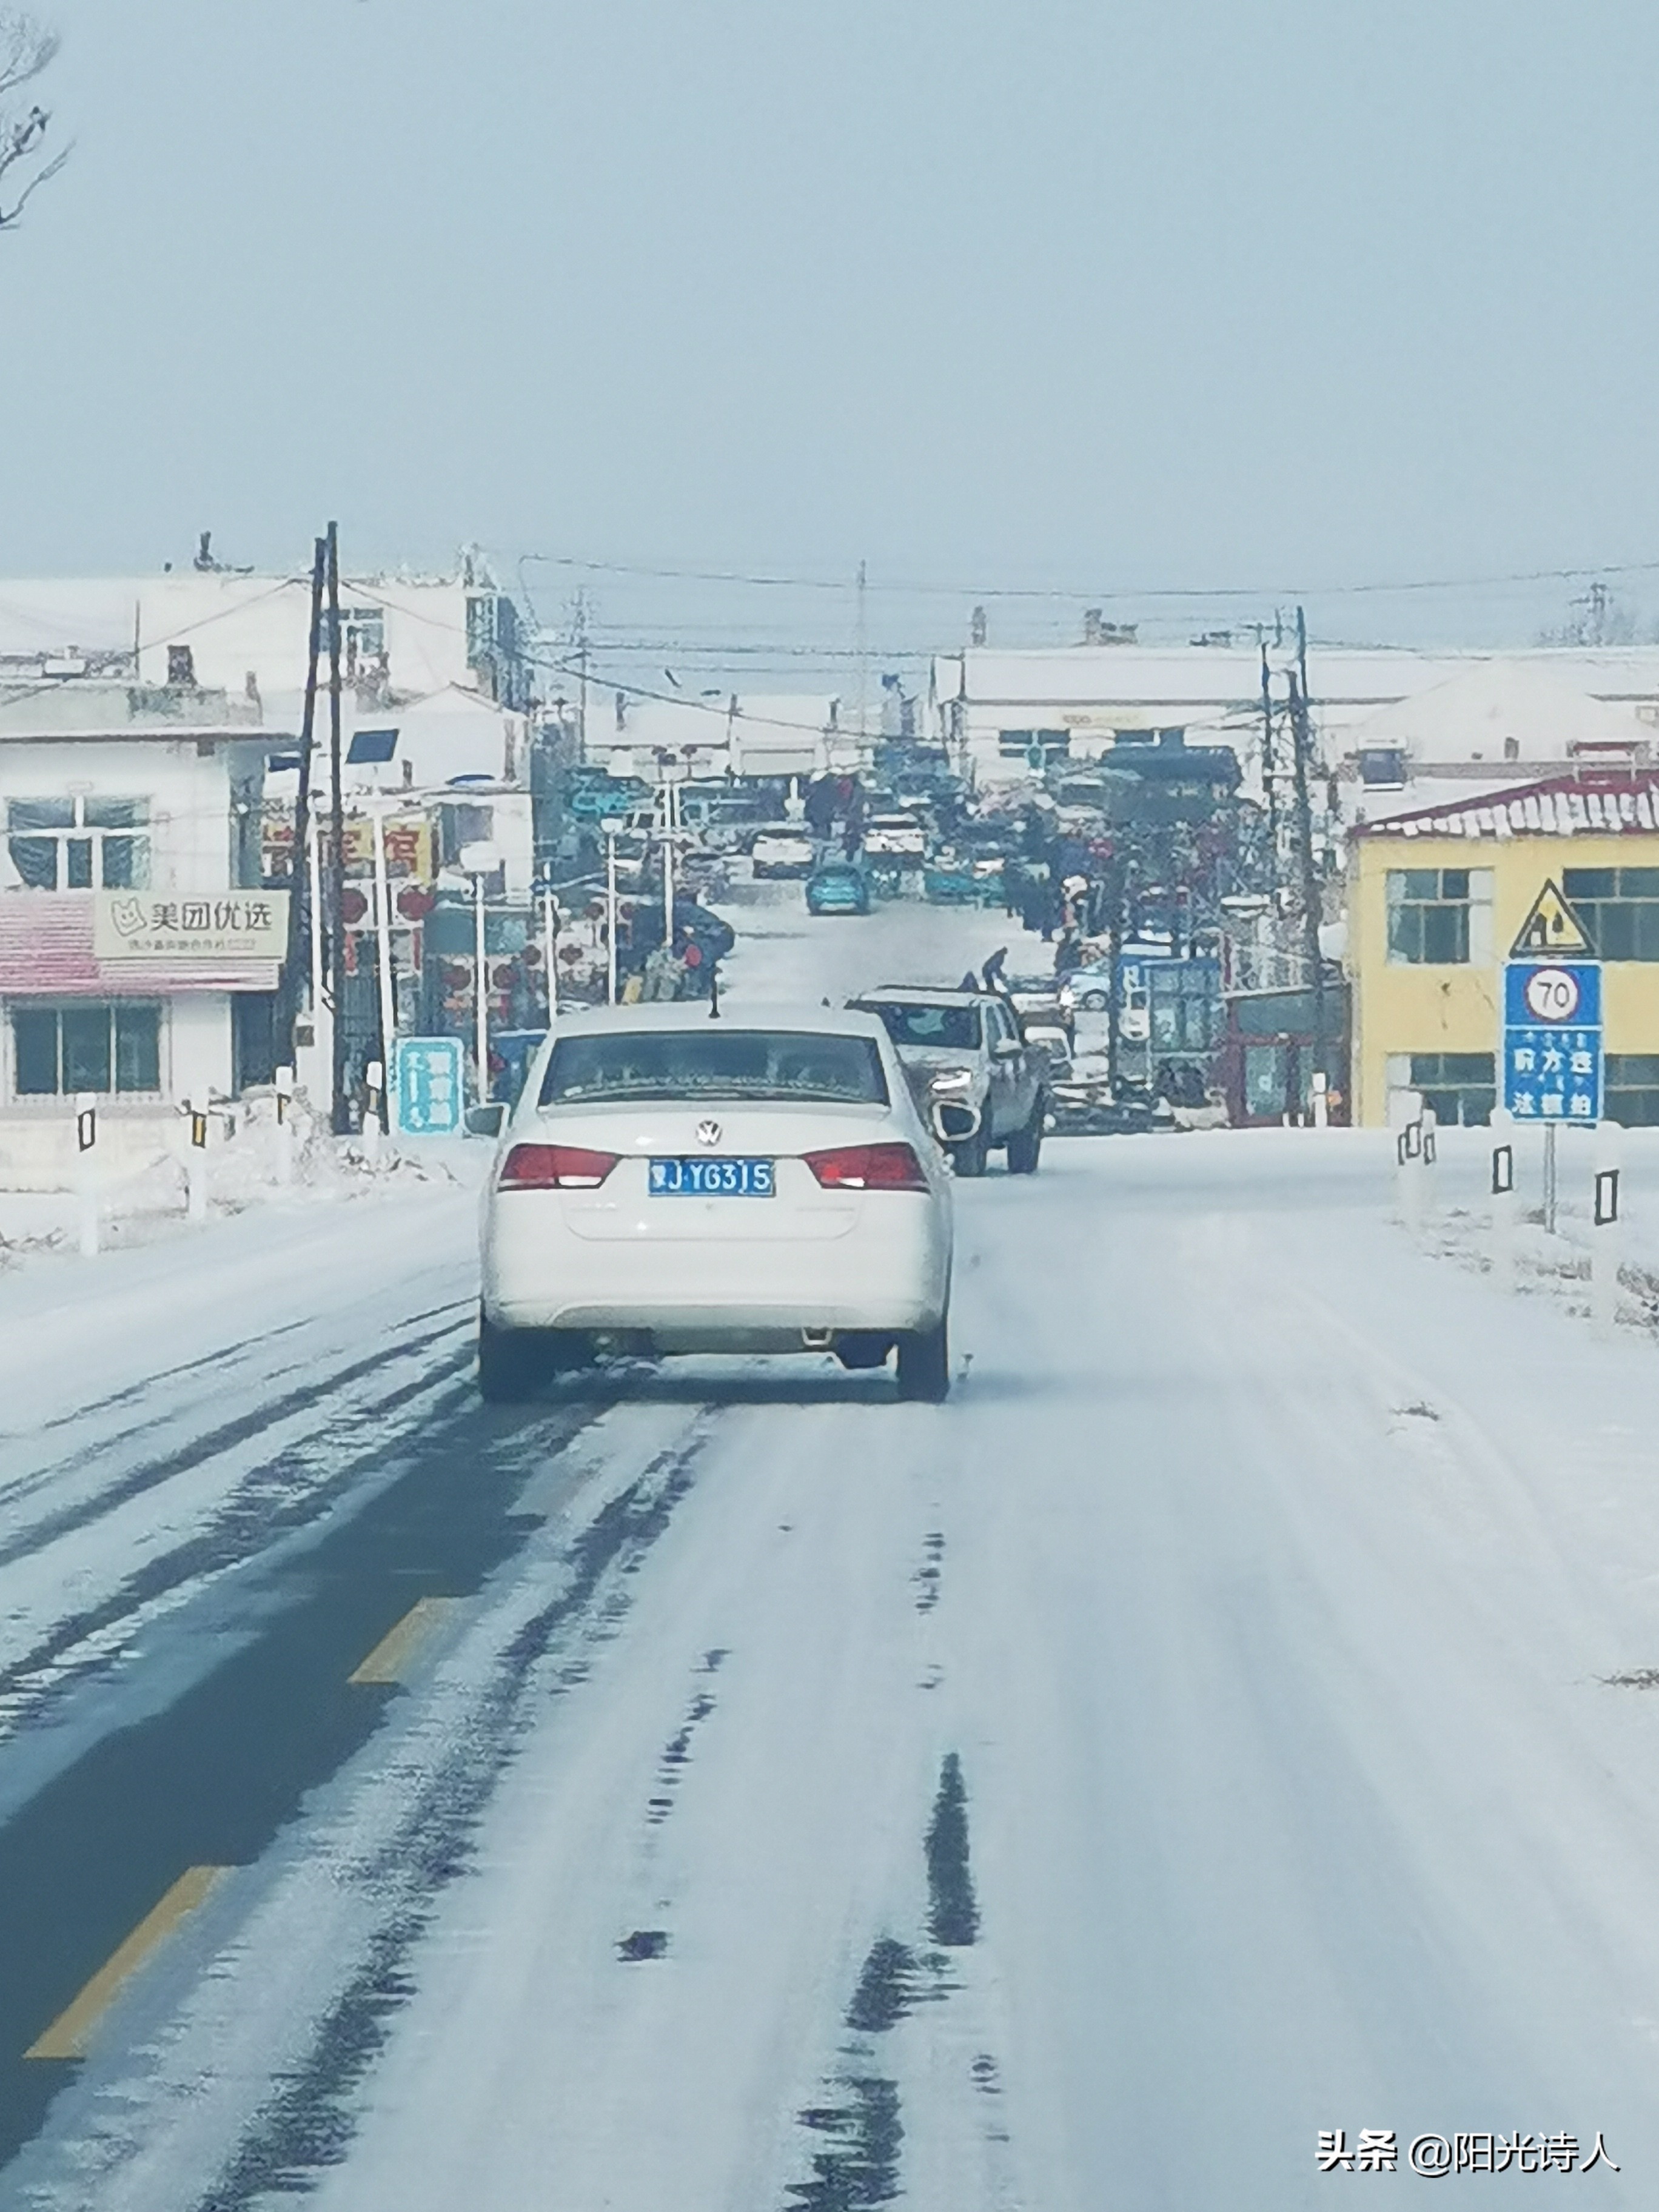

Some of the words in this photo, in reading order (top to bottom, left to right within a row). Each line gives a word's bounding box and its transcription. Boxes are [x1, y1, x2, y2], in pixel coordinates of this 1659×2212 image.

[151, 900, 273, 931] 美团优选
[1537, 982, 1570, 1008] 70
